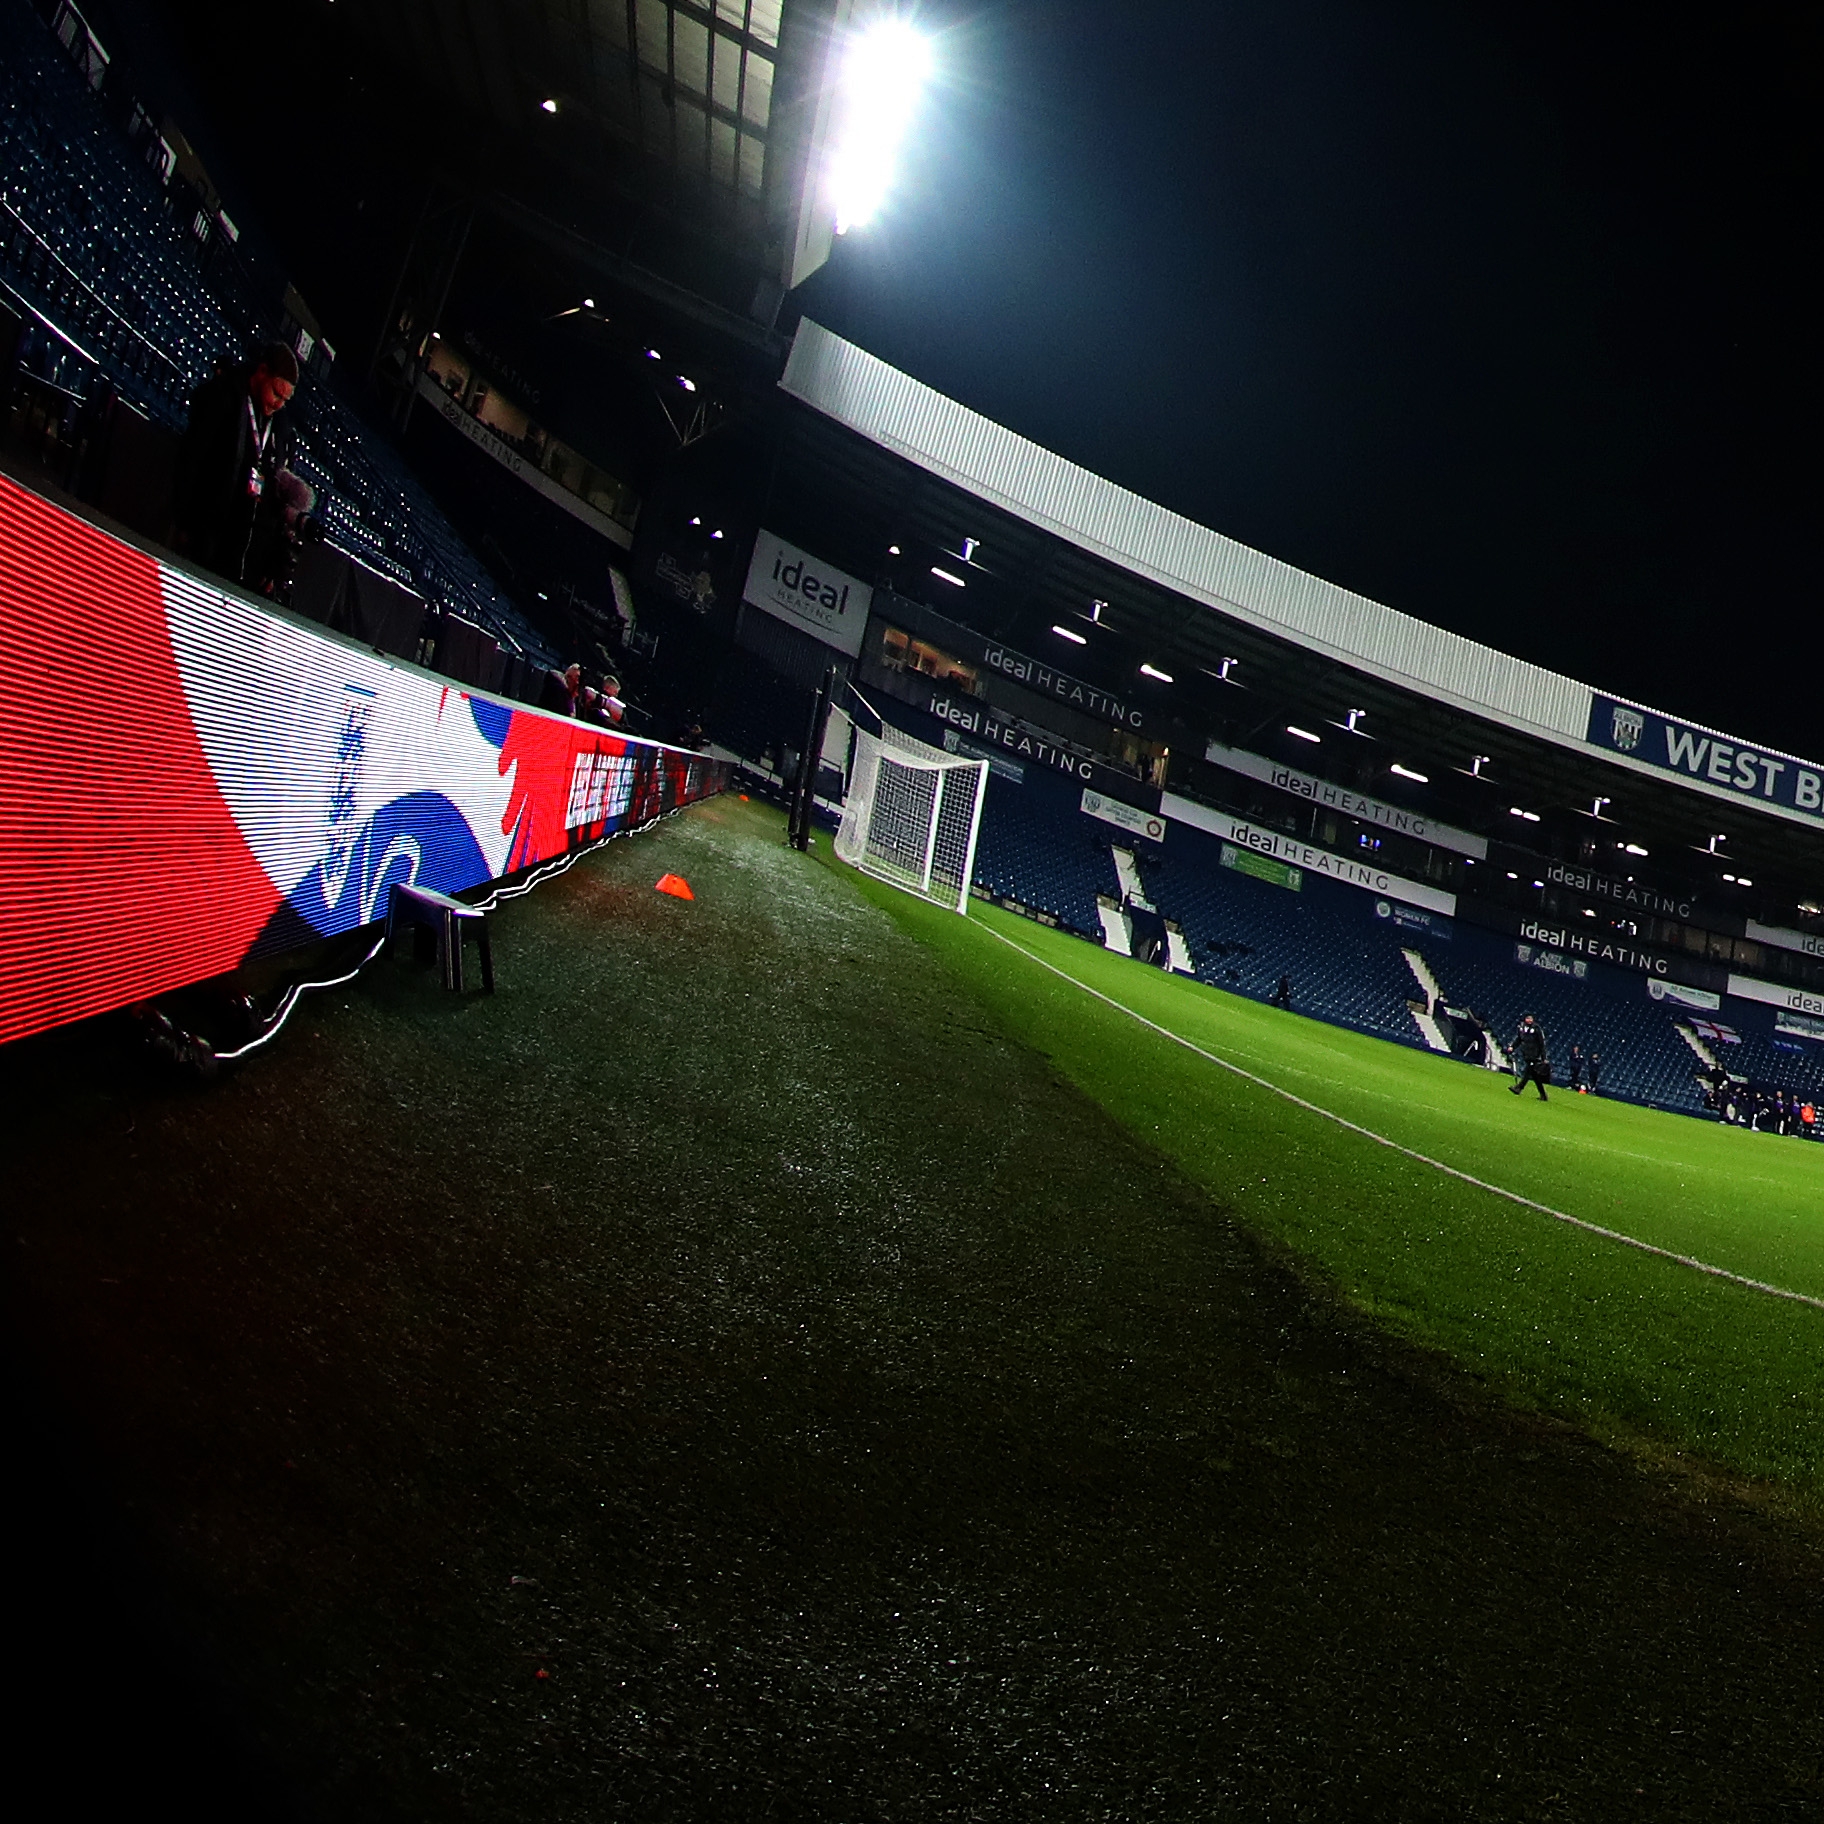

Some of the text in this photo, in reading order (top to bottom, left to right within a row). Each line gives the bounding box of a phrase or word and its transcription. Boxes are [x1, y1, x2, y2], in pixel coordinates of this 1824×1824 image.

[463, 415, 523, 473] HEATING
[772, 550, 849, 615] ideal
[984, 645, 1143, 727] ideal HEATING
[929, 693, 980, 732] ideal
[984, 720, 1093, 780] HEATING
[1665, 725, 1785, 797] WEST
[1271, 769, 1426, 836] ideal HEATING
[1230, 820, 1278, 855] ideal
[1283, 838, 1390, 891] HEATING
[1547, 864, 1690, 918] ideal HEATING
[1520, 918, 1669, 974] ideal HEATING
